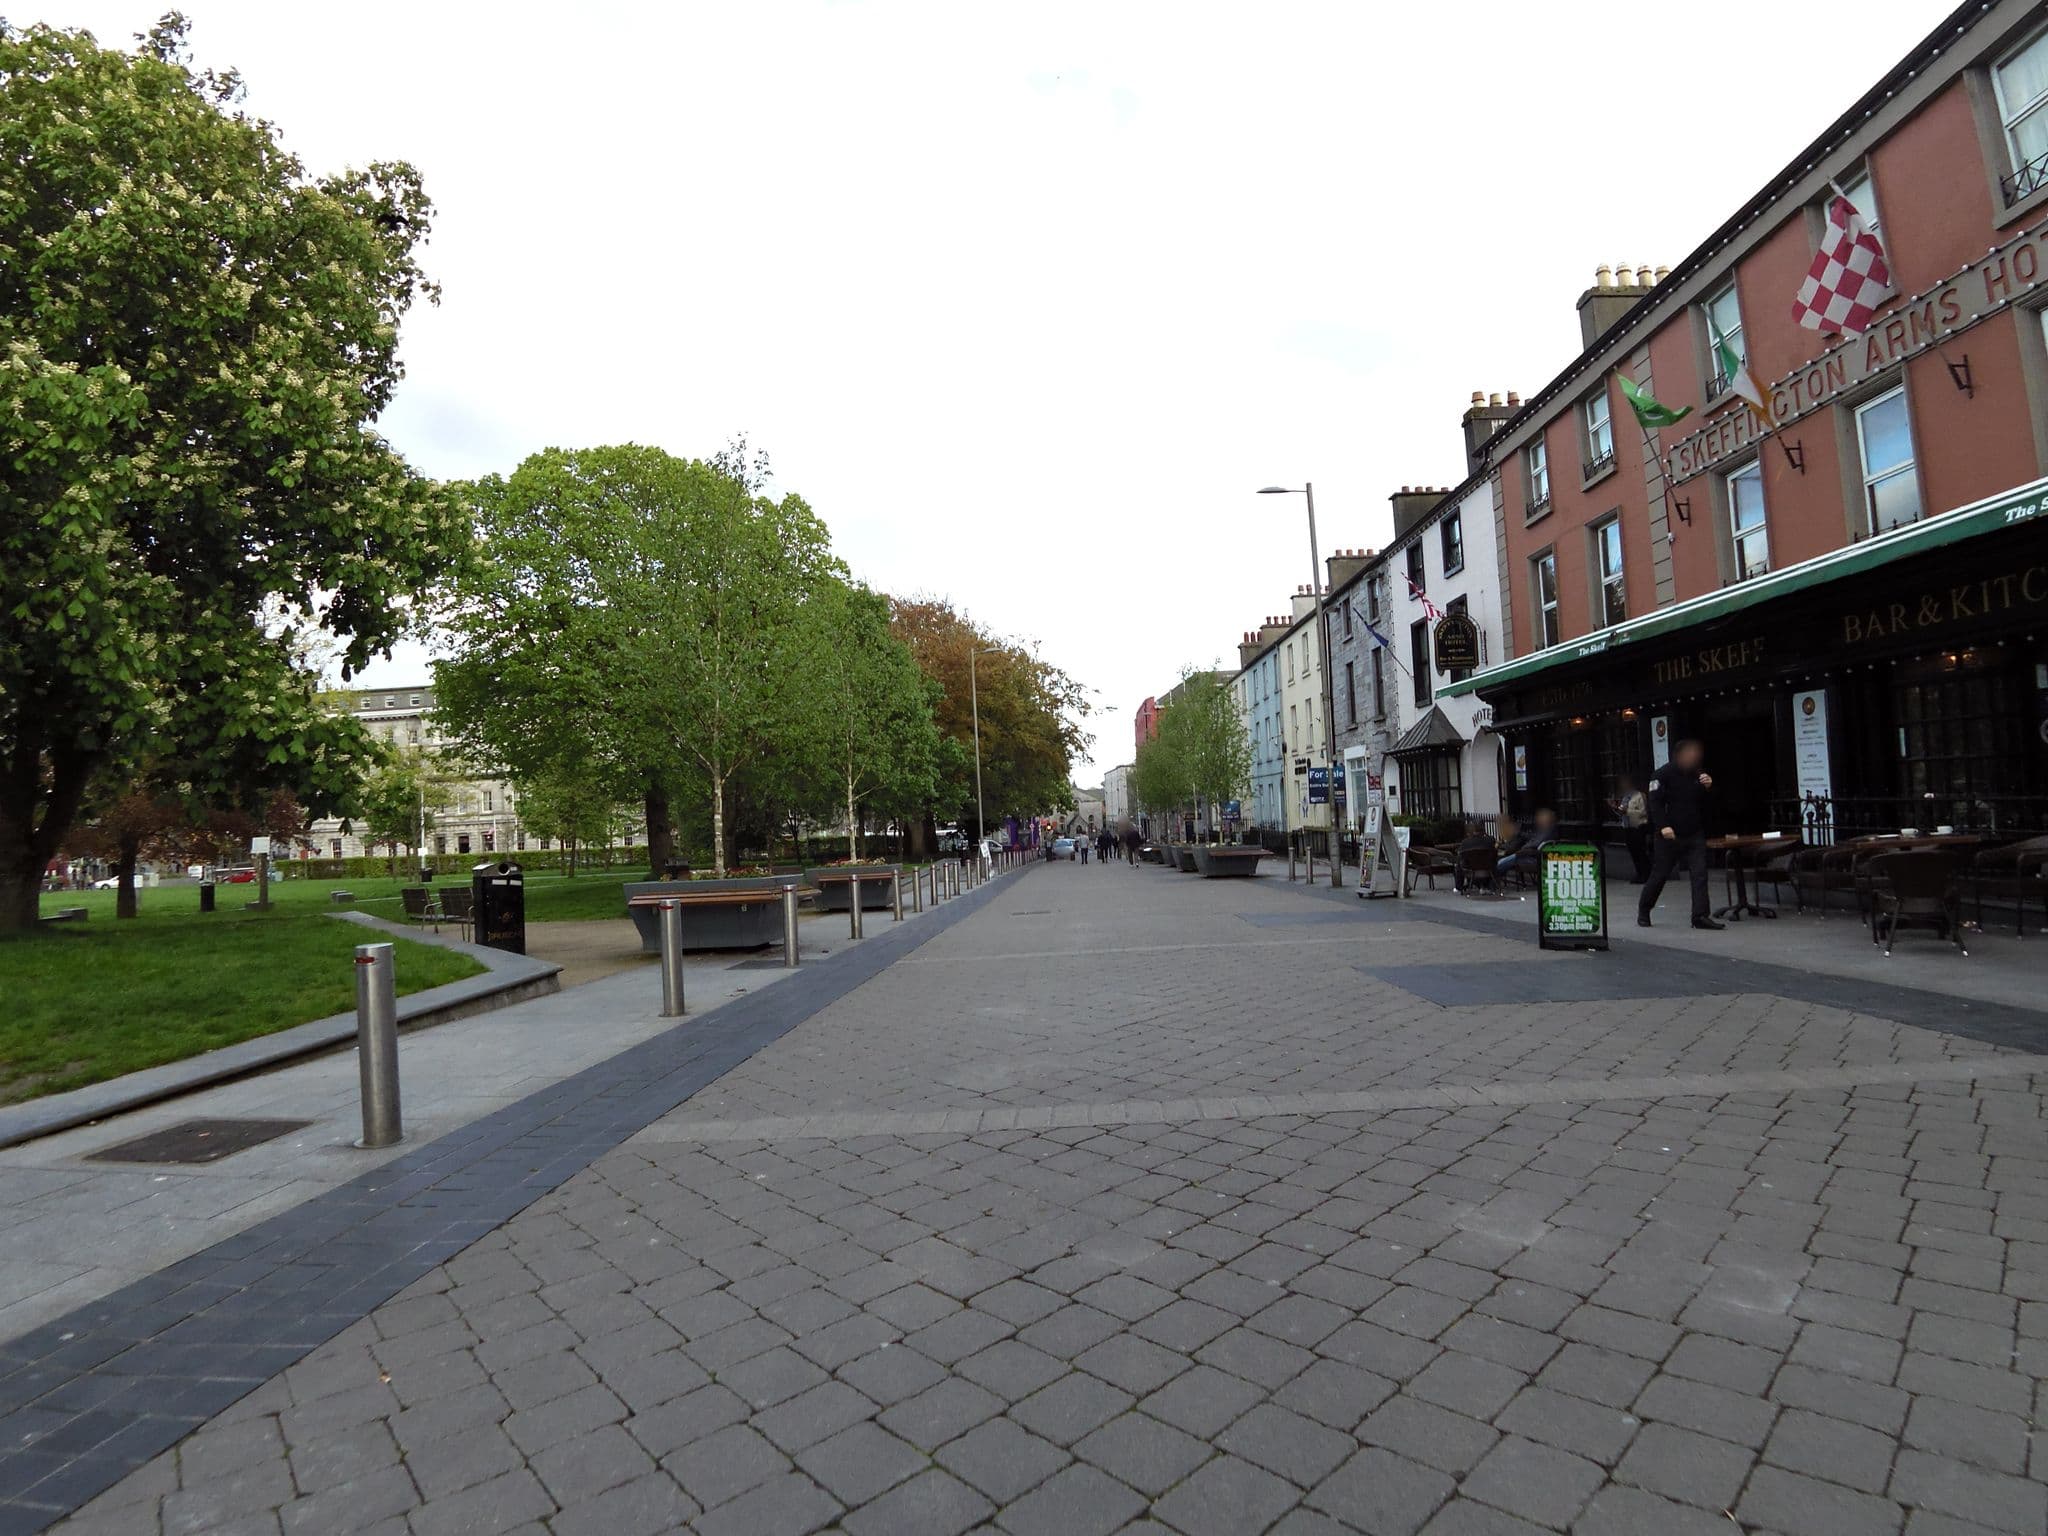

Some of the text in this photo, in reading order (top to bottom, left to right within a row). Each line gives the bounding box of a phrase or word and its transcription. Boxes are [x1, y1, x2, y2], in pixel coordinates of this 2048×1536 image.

[1866, 287, 1962, 372] ARMS
[2005, 504, 2036, 522] The
[1843, 603, 1910, 643] BAR
[1917, 593, 1944, 626] &
[1654, 655, 1692, 683] THE
[1309, 770, 1323, 779] For
[1547, 861, 1593, 879] FREE
[1545, 879, 1596, 899] TOUR
